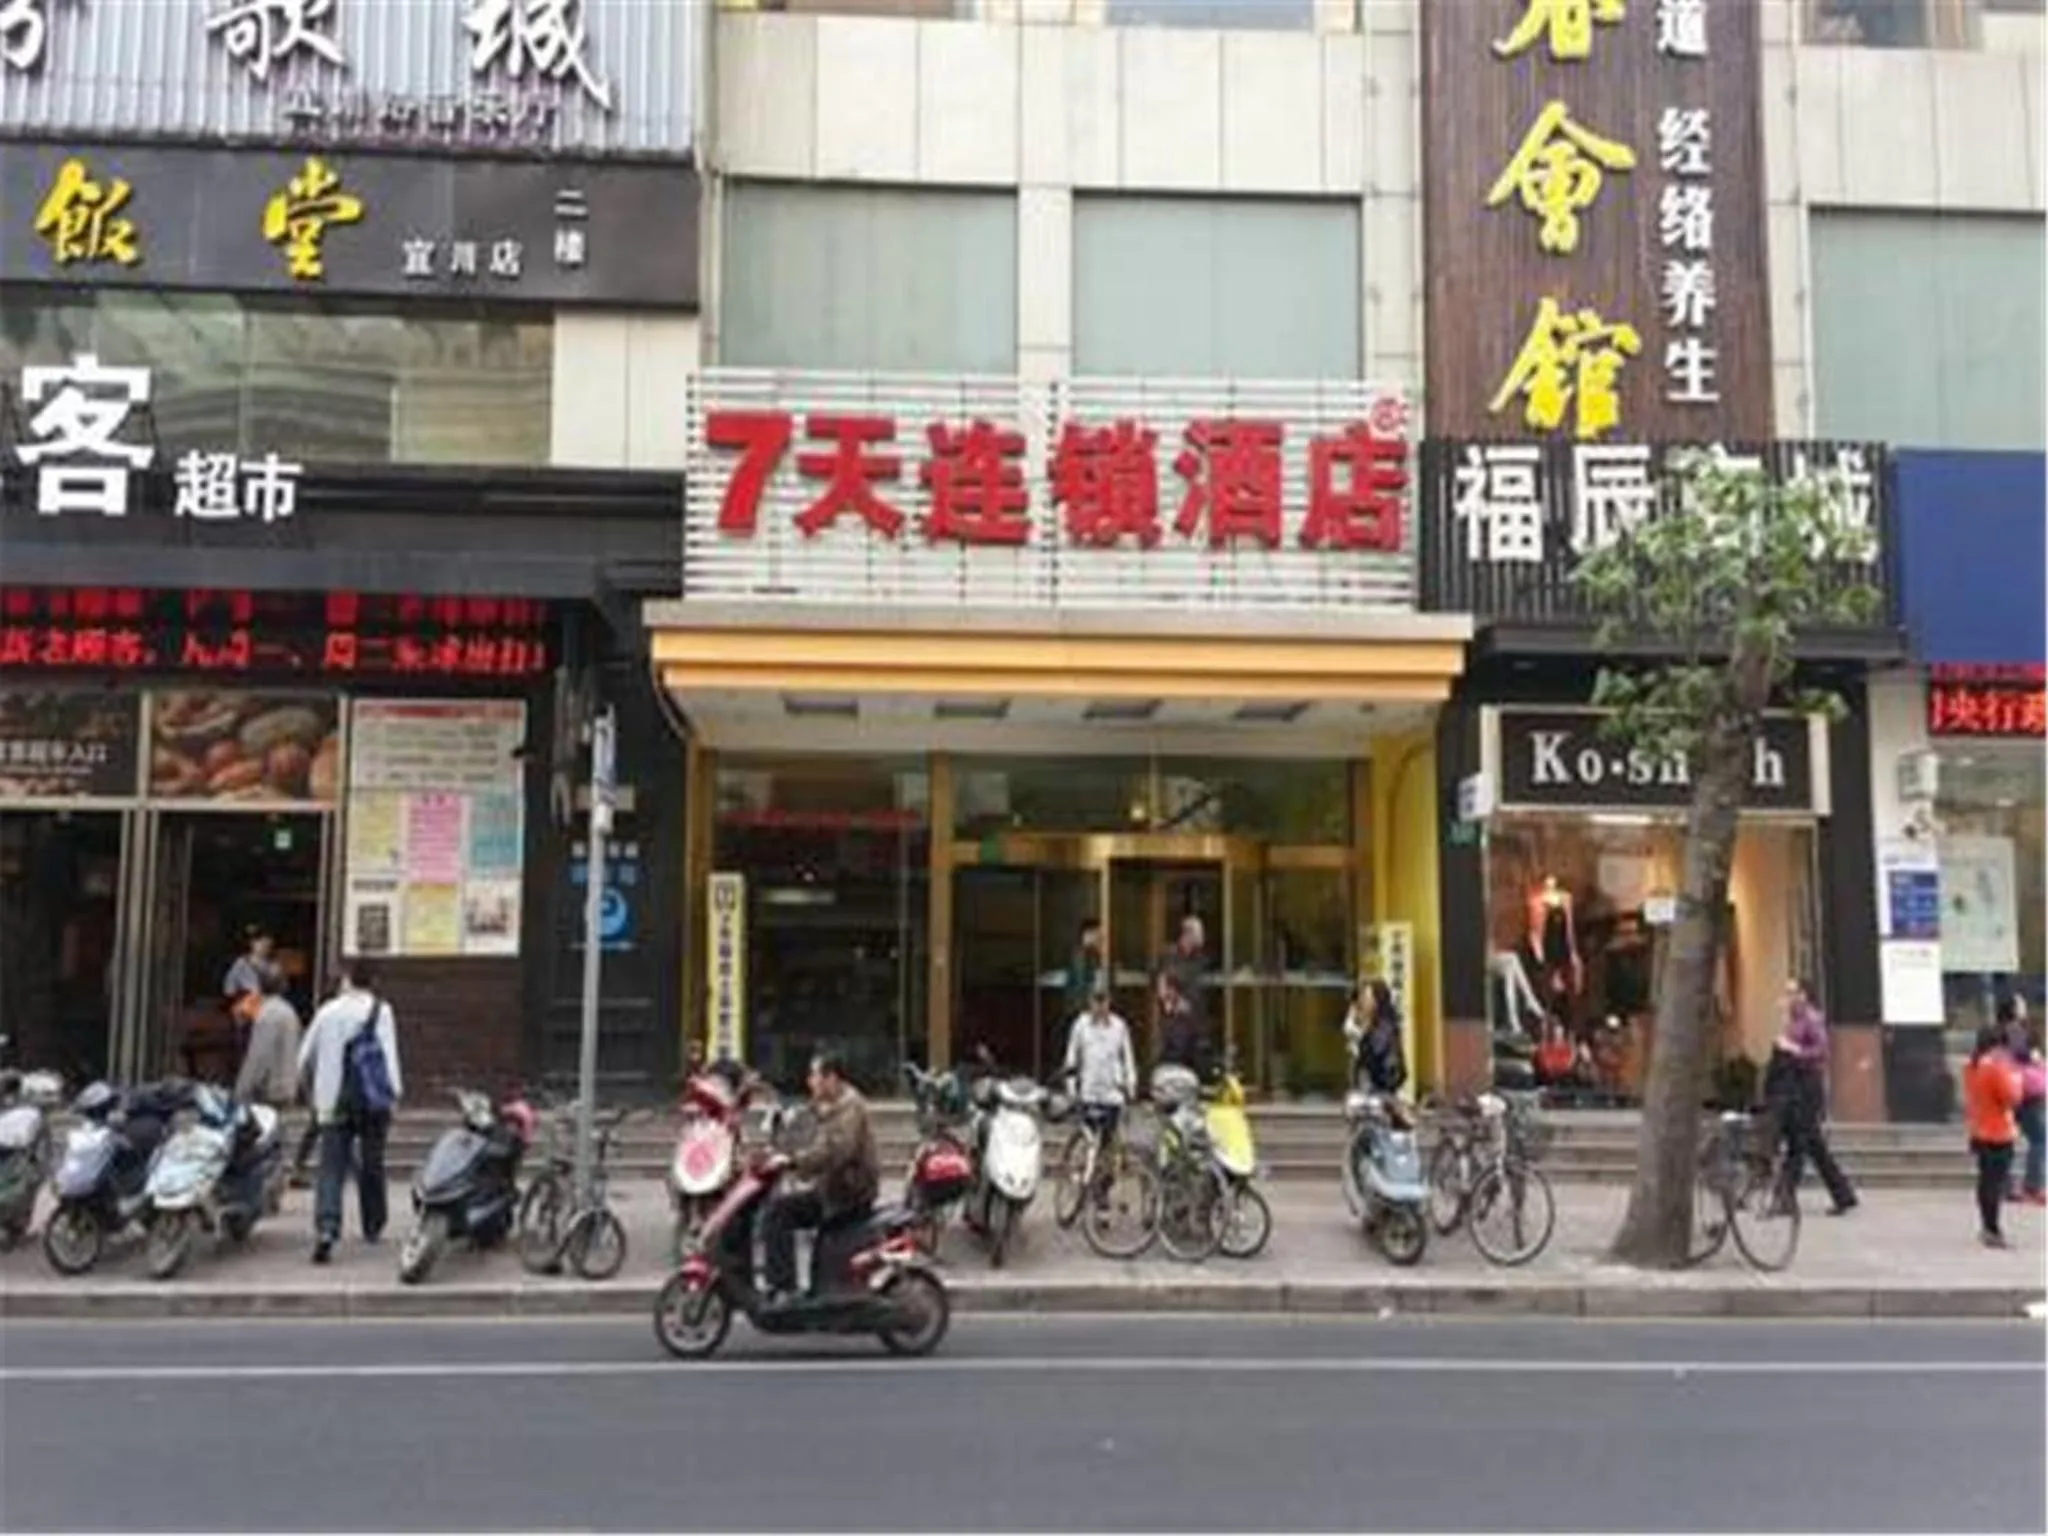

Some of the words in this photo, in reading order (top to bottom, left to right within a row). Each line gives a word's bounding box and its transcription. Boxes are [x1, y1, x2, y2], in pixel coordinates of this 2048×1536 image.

[1658, 107, 1719, 403] 经络养生
[174, 449, 304, 521] 超市
[704, 410, 1410, 551] 7天连锁酒店
